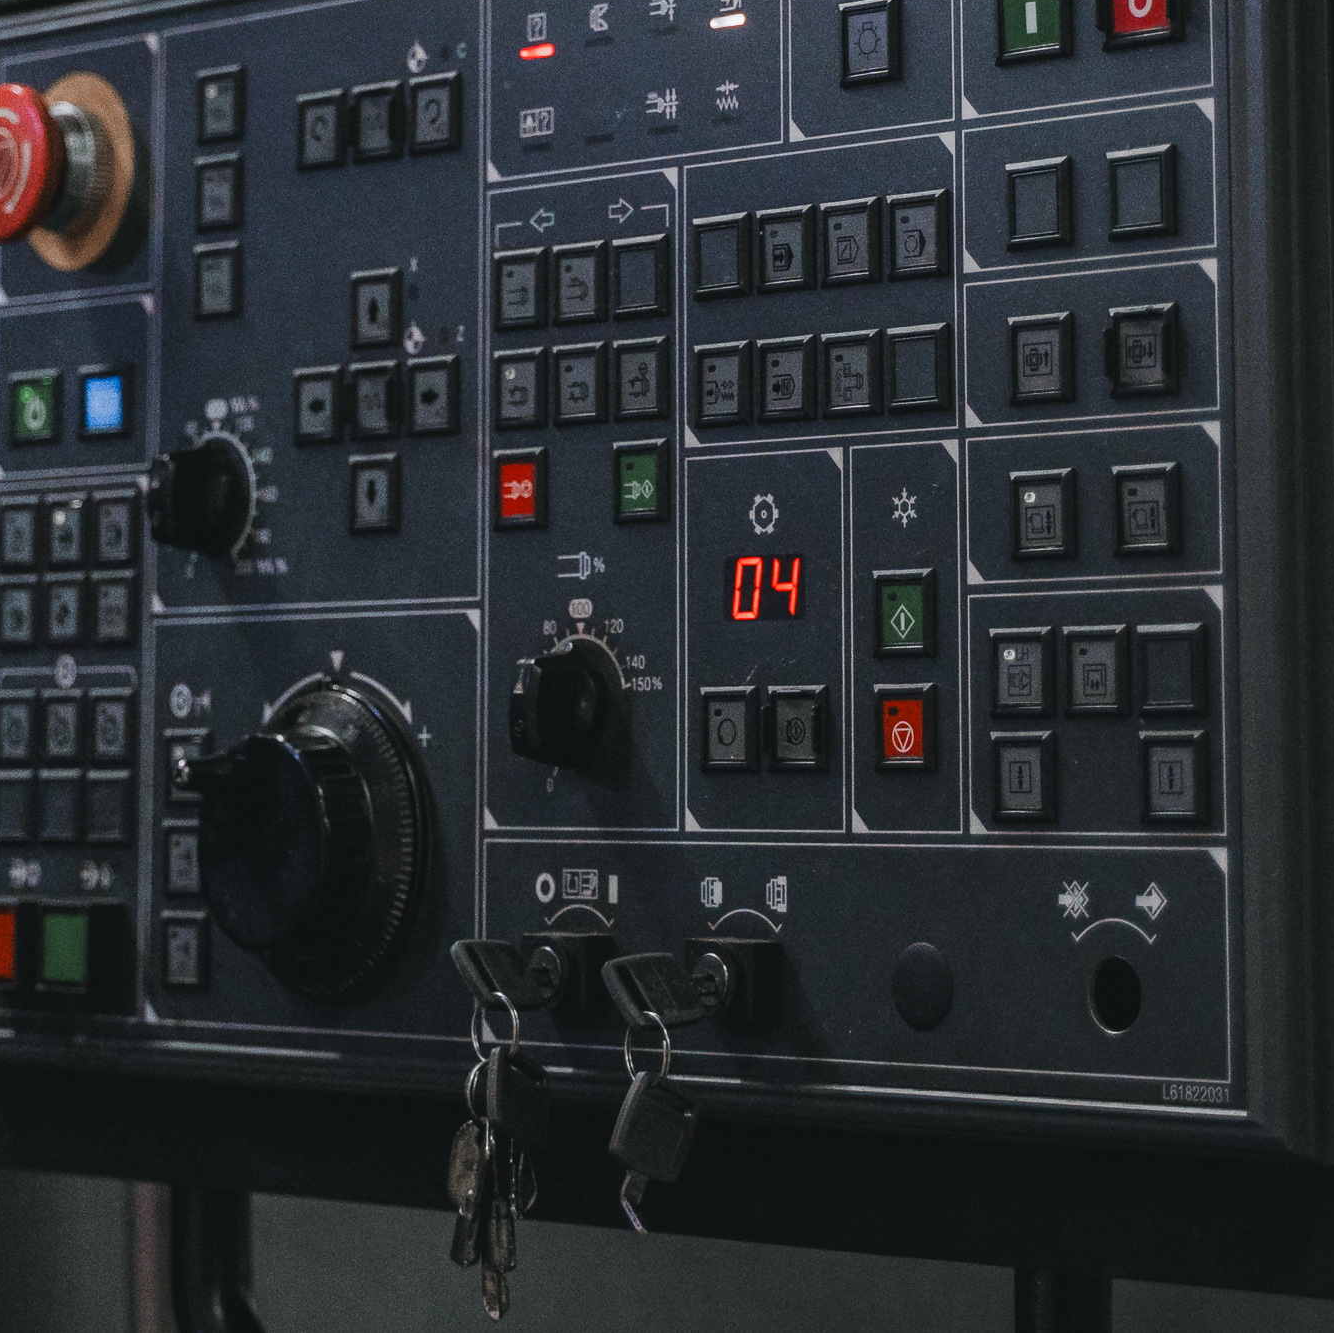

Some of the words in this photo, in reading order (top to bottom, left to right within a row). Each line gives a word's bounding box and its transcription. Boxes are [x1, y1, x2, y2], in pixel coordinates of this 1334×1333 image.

[732, 556, 800, 620] 04
[543, 619, 557, 636] 80
[605, 619, 624, 634] 120
[625, 655, 645, 670] 140
[631, 676, 663, 691] 150%
[1163, 1084, 1229, 1103] L61822031
